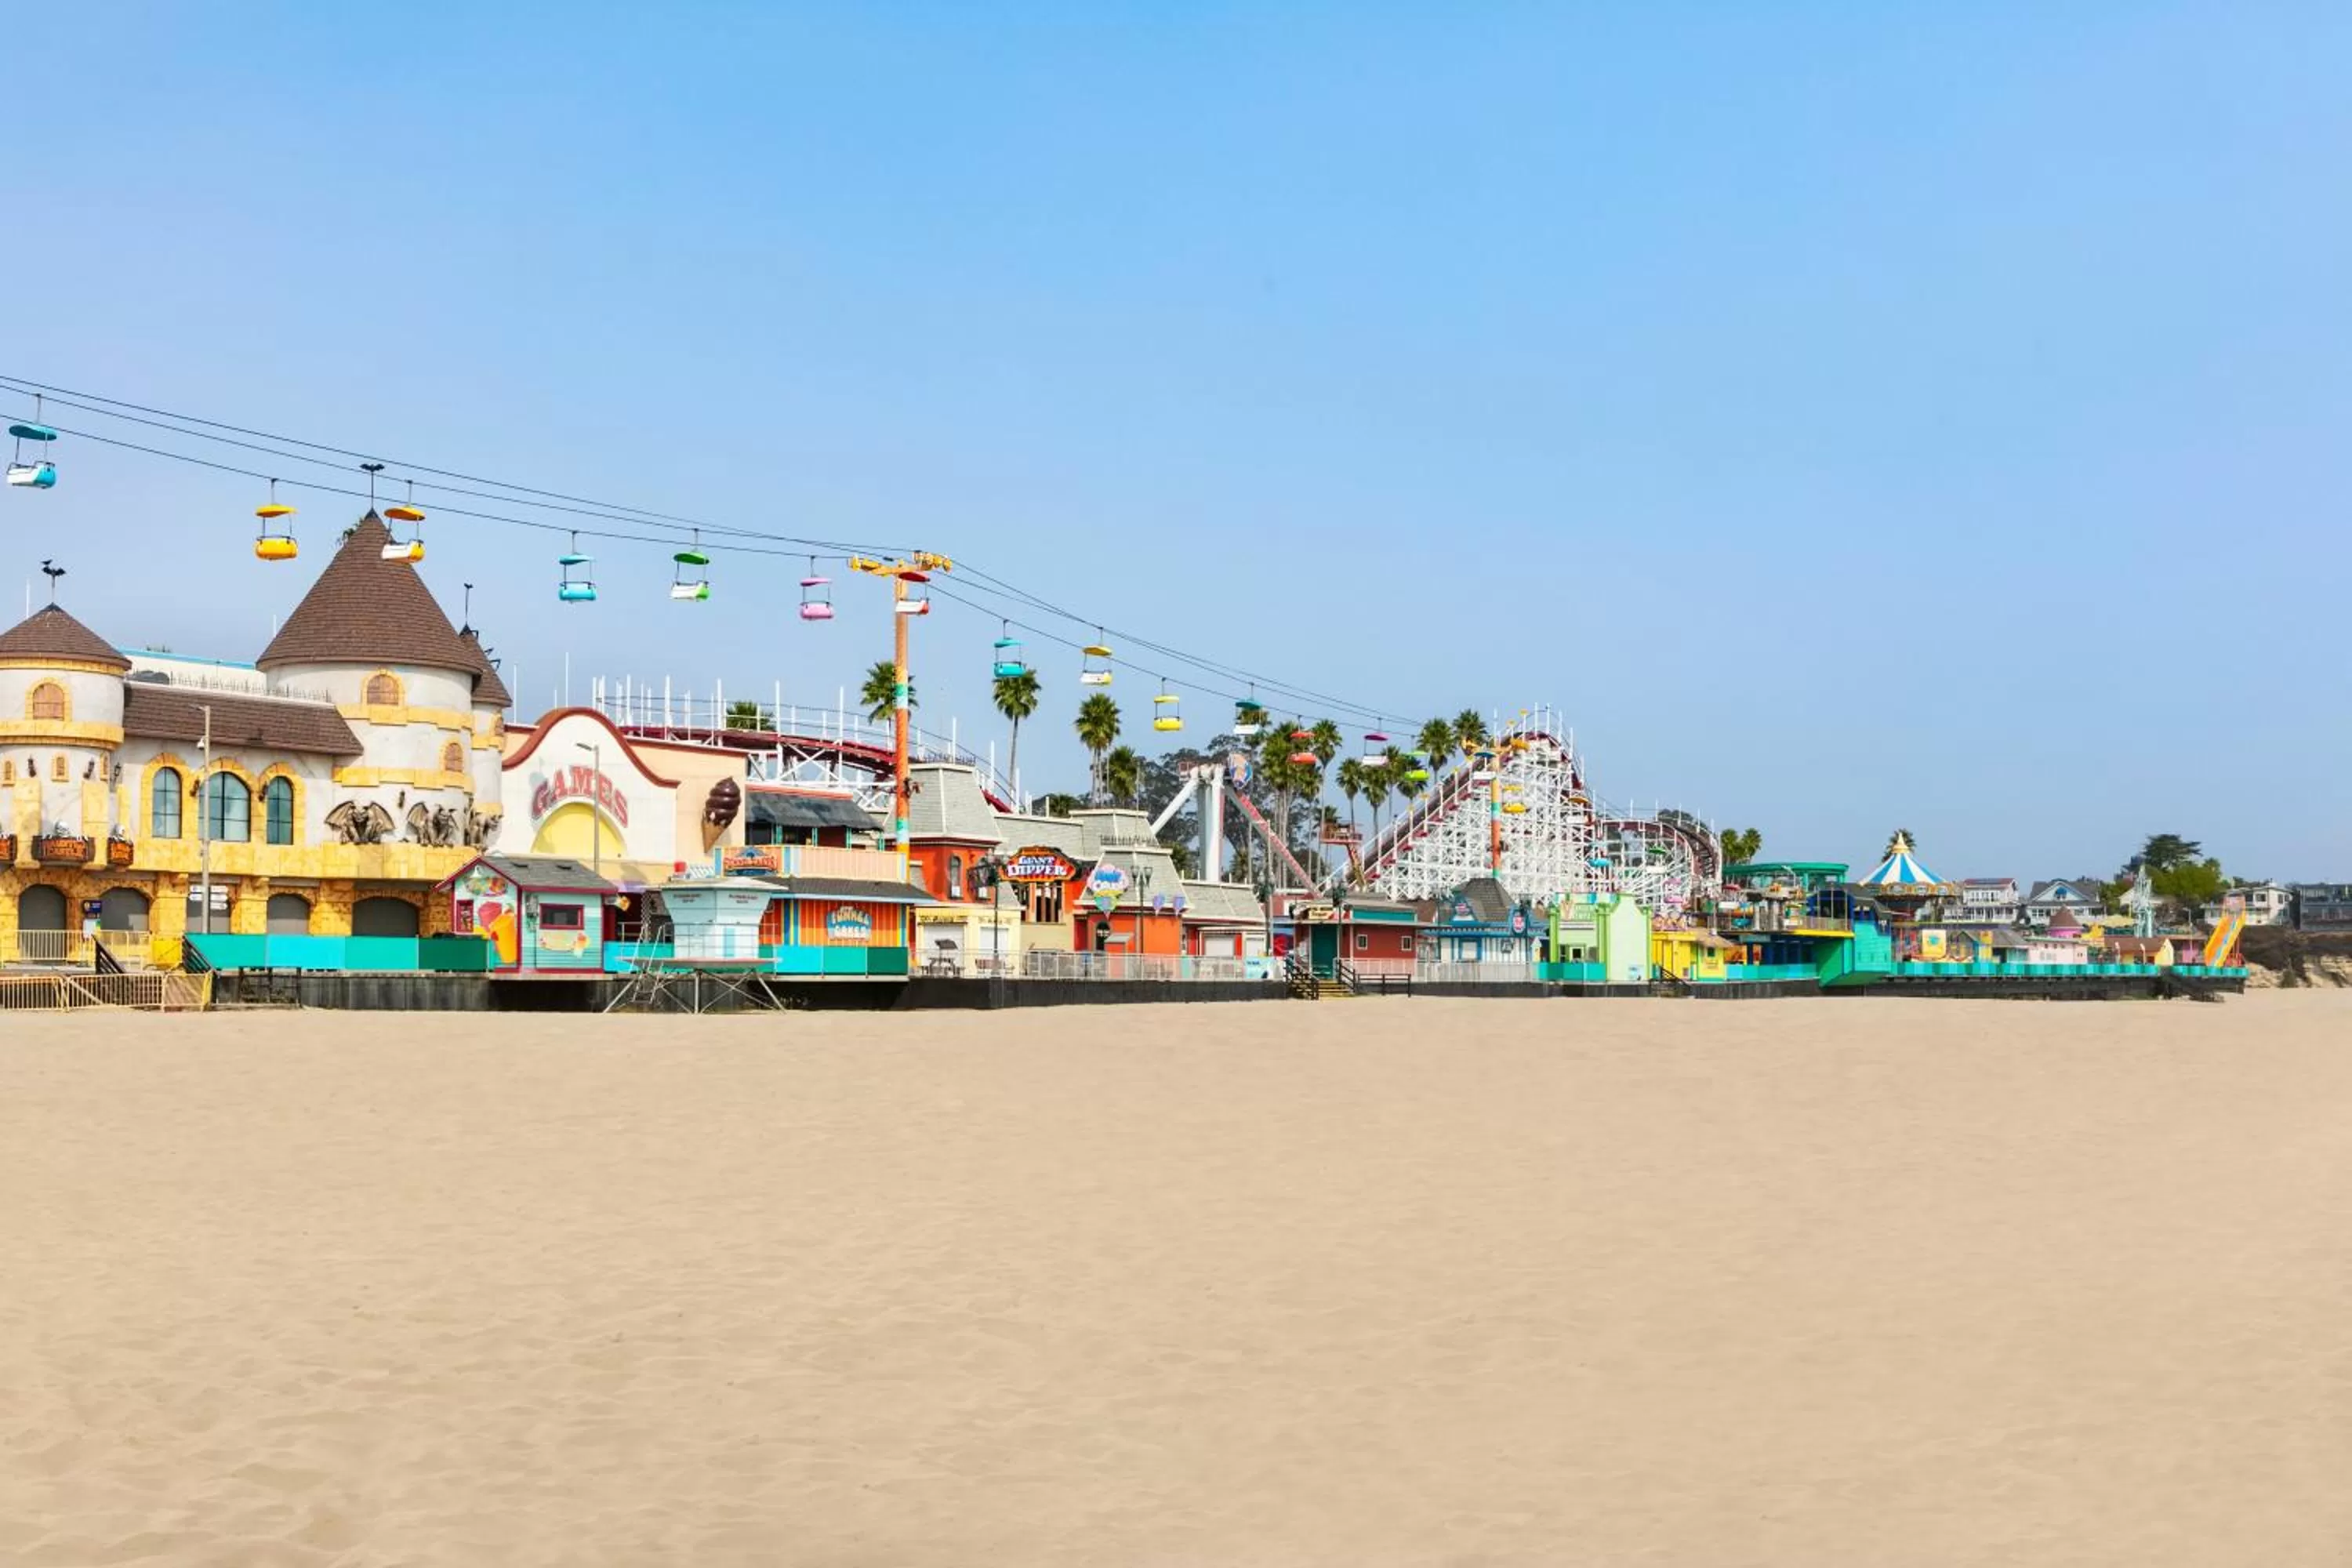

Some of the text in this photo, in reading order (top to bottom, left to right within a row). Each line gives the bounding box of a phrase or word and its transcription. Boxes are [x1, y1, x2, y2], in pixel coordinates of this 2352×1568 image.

[529, 765, 628, 828] GAMES
[1018, 855, 1056, 865] GIANT
[1007, 864, 1067, 877] DIPPER
